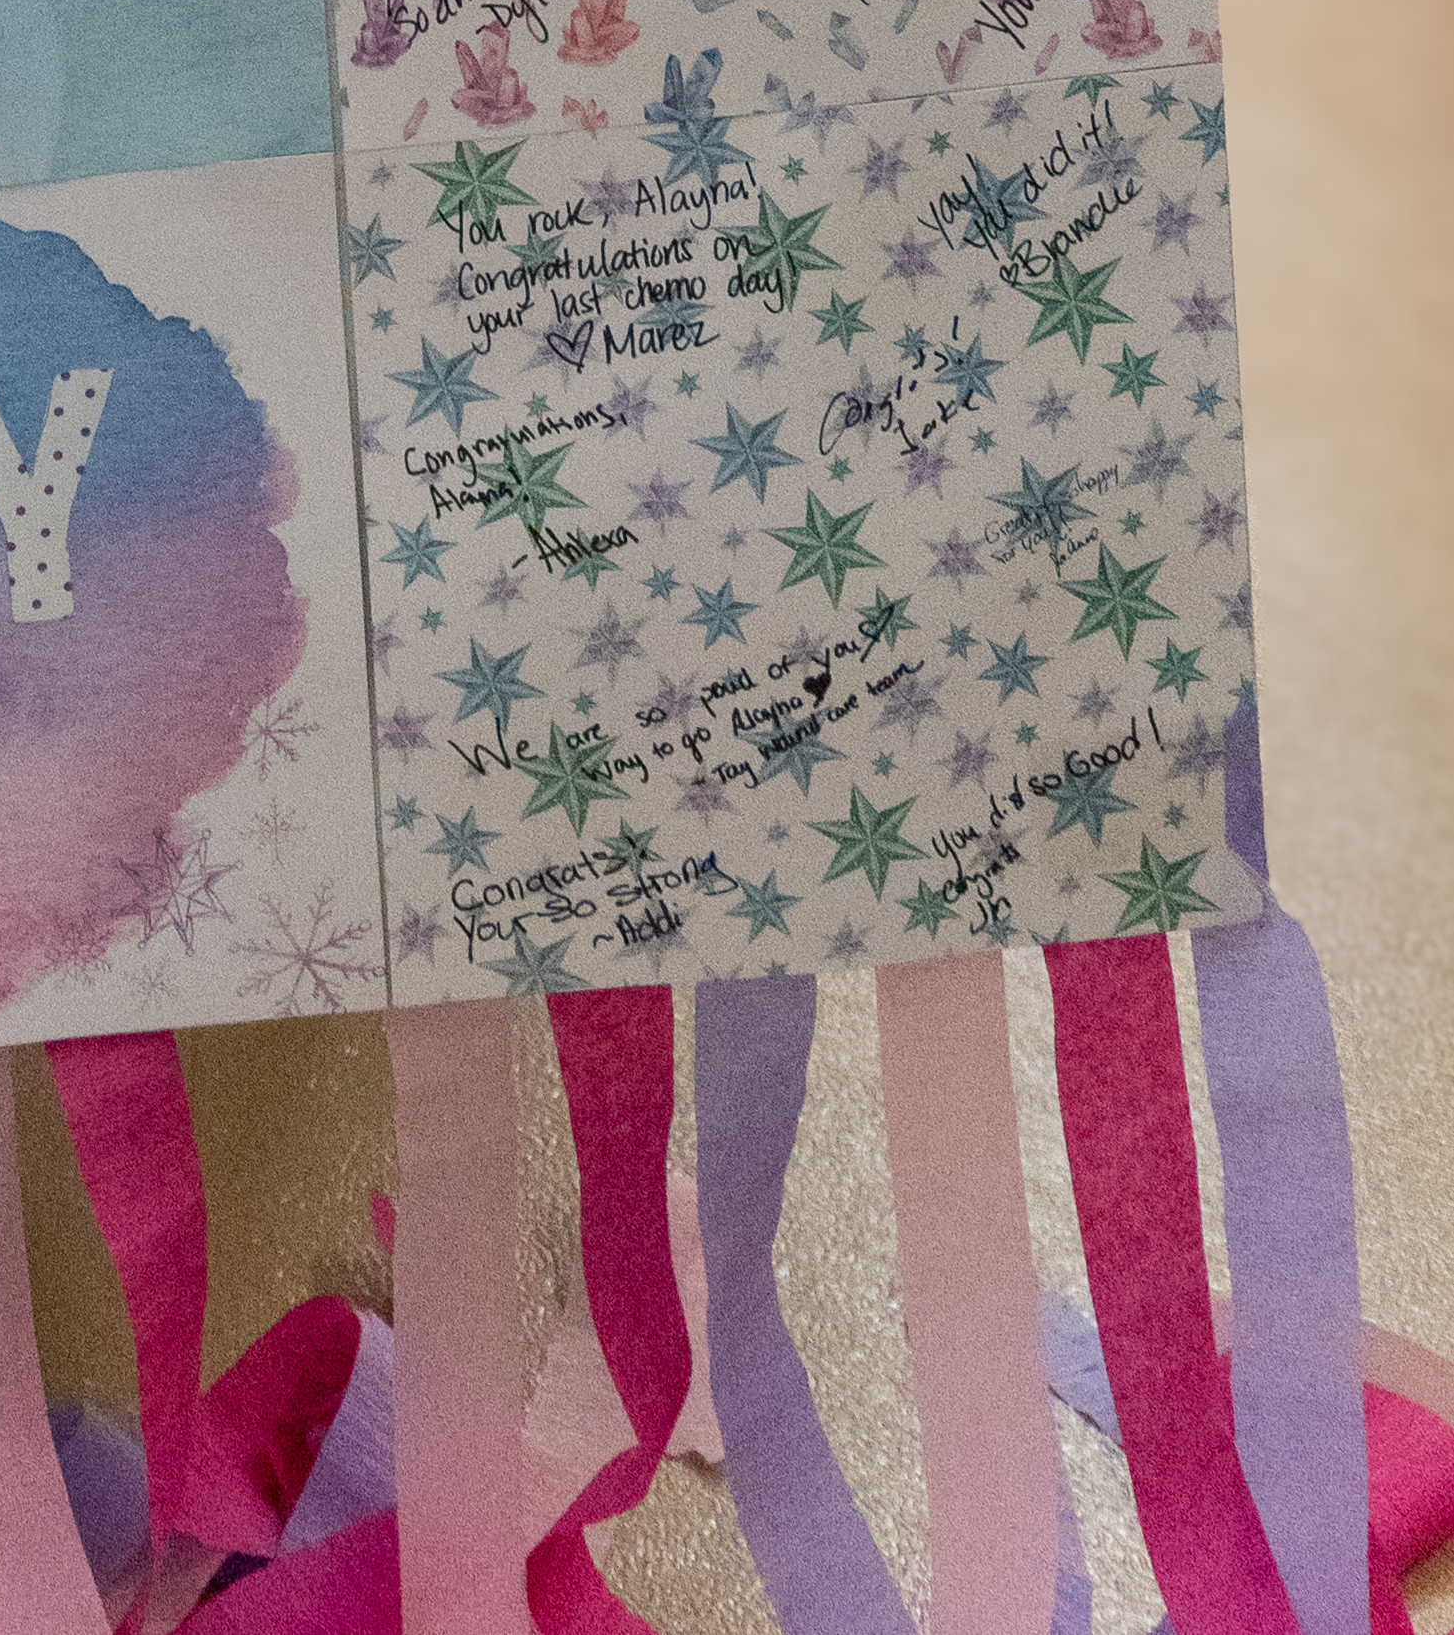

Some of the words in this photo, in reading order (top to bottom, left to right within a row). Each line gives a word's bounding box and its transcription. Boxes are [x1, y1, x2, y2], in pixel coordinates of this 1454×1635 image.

[1022, 131, 1075, 203] did
[438, 200, 506, 253] You
[528, 199, 611, 228] rock,
[635, 161, 761, 230] Alayna!
[714, 234, 777, 261] on
[467, 302, 535, 354] your
[552, 282, 602, 322] last
[625, 277, 705, 310] chemo
[449, 716, 540, 776] We
[565, 724, 609, 750] are
[637, 706, 667, 728] so
[768, 655, 798, 681] of
[812, 640, 862, 676] you
[821, 695, 859, 725] care
[865, 659, 926, 697] team
[651, 740, 675, 760] to
[682, 729, 713, 764] go
[1028, 773, 1062, 795] so
[1065, 707, 1165, 778] Good!
[616, 902, 684, 946] Addi
